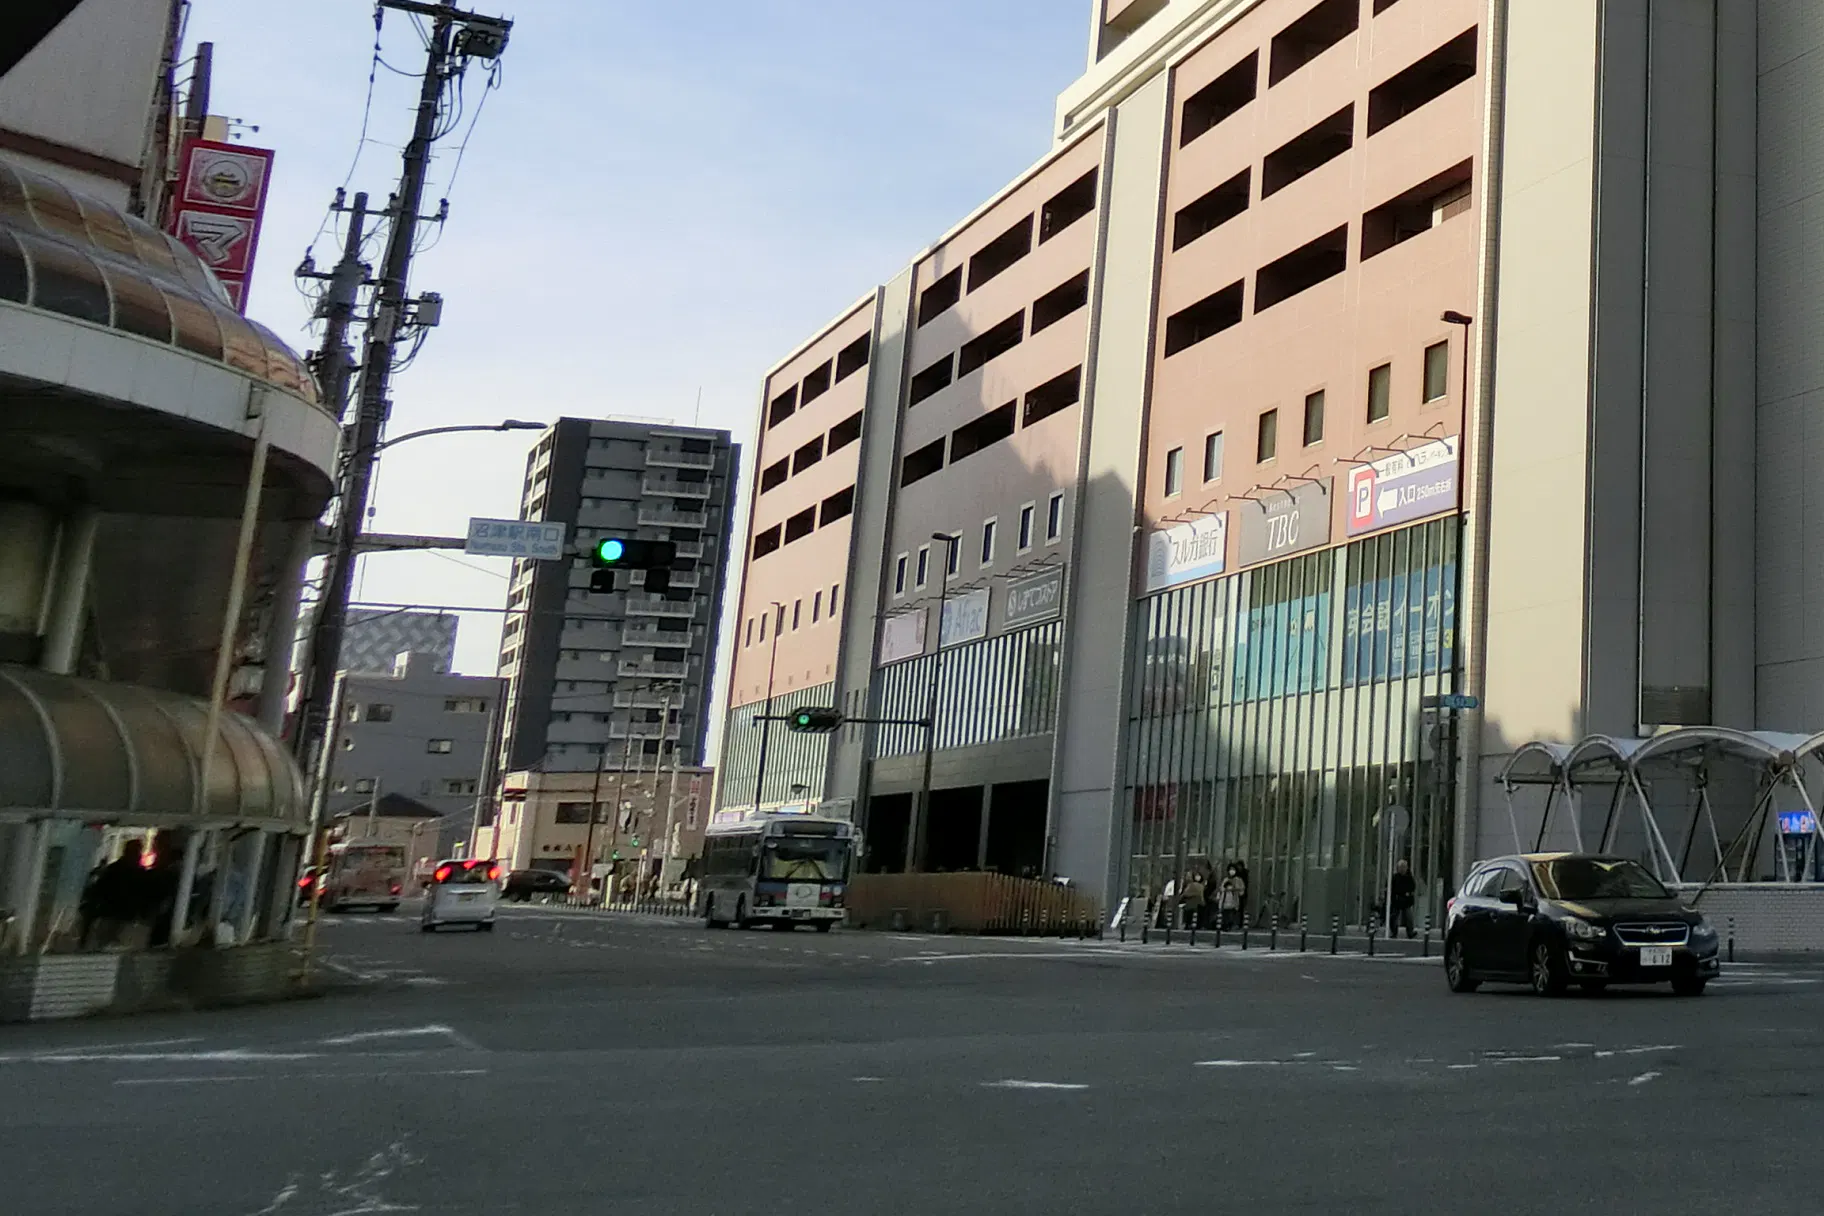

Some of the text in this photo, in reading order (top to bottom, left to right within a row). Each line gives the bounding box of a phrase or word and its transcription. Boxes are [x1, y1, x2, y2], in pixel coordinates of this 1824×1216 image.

[1398, 484, 1416, 508] 入口
[1170, 529, 1218, 568] スルガ銀行
[1267, 510, 1300, 552] TBC
